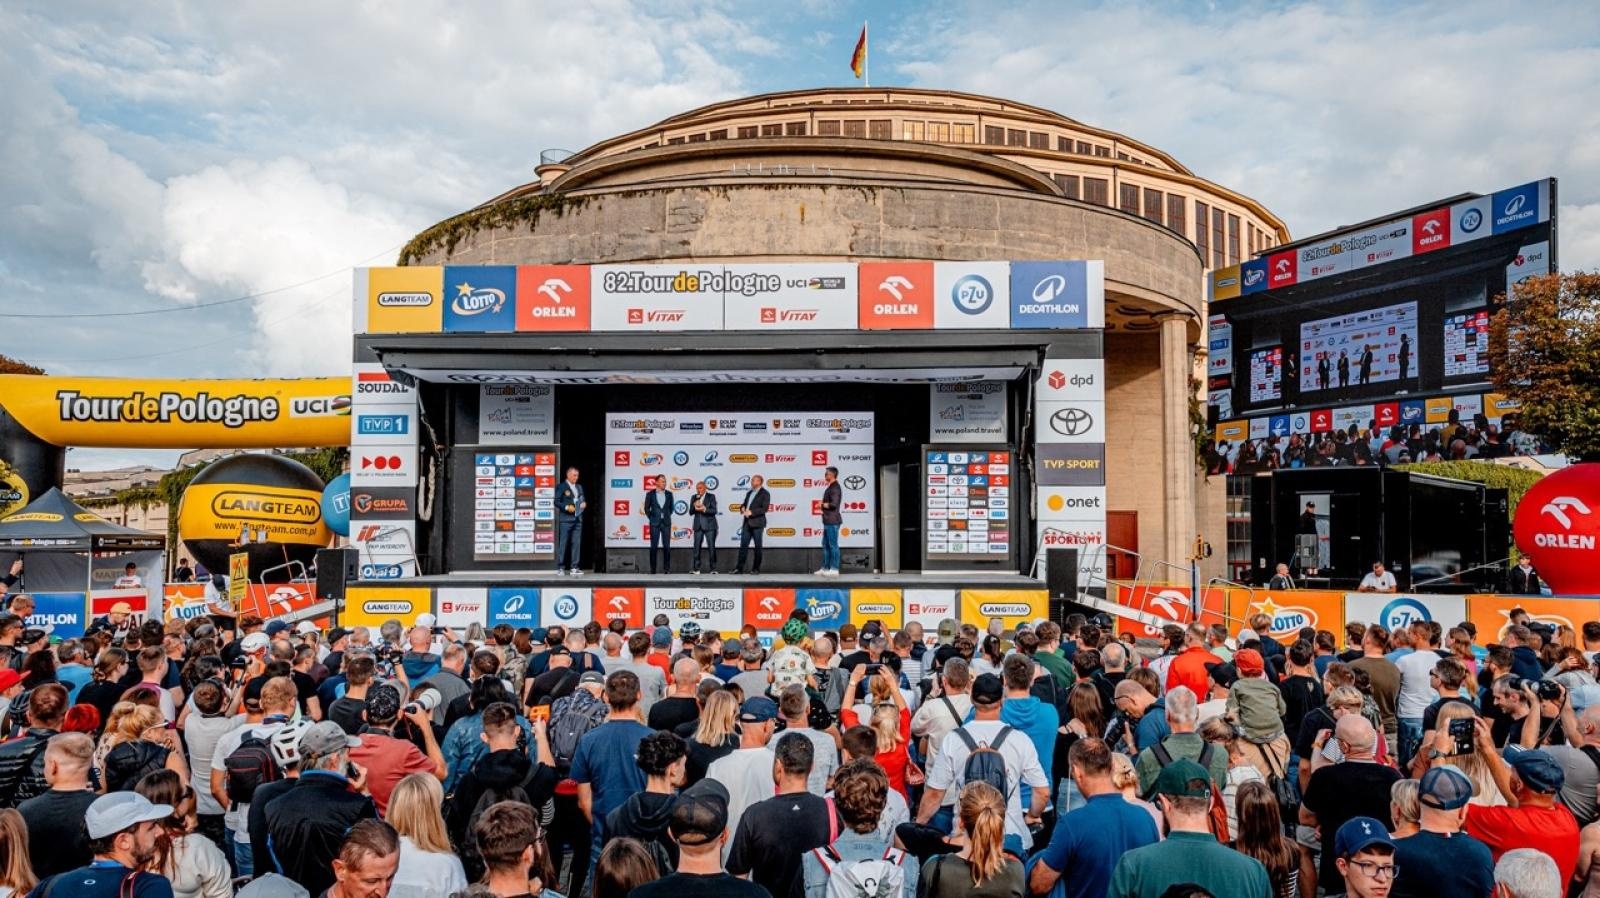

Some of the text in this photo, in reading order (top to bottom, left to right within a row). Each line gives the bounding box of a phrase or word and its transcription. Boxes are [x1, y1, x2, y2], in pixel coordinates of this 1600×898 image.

[1497, 210, 1539, 225] DECATHLON
[1527, 253, 1543, 263] dpd
[604, 271, 781, 295] 82.TourdePologne
[786, 279, 807, 289] UCI
[382, 295, 430, 304] LANGTEAM
[961, 286, 985, 304] PZU
[463, 292, 496, 311] LOTTO
[532, 306, 576, 318] ORLEN
[873, 304, 918, 315] ORLEN
[1019, 304, 1079, 314] DECATHLON
[647, 310, 686, 322] VITAY
[780, 309, 819, 322] VITAY
[1069, 374, 1094, 388] dpd
[358, 384, 409, 394] SOUDAL
[56, 389, 329, 428] TourdePologne UCI
[364, 417, 403, 431] TVP 1
[1043, 459, 1100, 469] TVP SPORT
[373, 499, 407, 508] GRUPA
[1067, 494, 1100, 508] onet
[220, 499, 316, 517] LANGTEAM
[851, 528, 869, 536] onet
[1044, 535, 1102, 545] SPORTOWY
[1534, 533, 1596, 550] ORLEN
[366, 603, 410, 611] LANGTEAM
[454, 603, 480, 612] VITAY
[559, 602, 574, 613] PZU
[653, 597, 735, 611] TourdePologne
[921, 605, 948, 614] VITAY
[756, 612, 782, 620] ORLEN
[810, 605, 835, 616] LOTTO
[25, 613, 77, 625] ATHLON
